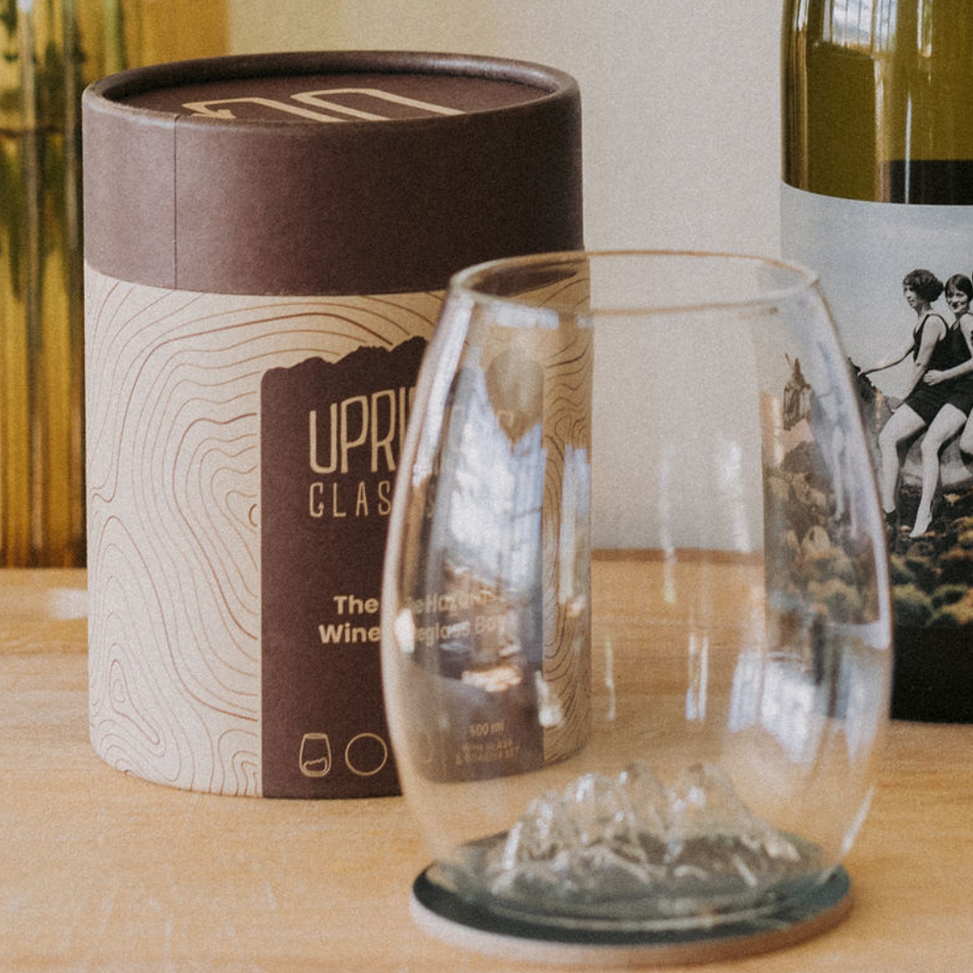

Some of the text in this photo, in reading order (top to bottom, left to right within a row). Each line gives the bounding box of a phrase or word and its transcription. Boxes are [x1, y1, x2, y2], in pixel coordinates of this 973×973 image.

[308, 385, 416, 475] UPRI
[308, 480, 393, 519] GLAS
[333, 594, 380, 616] The
